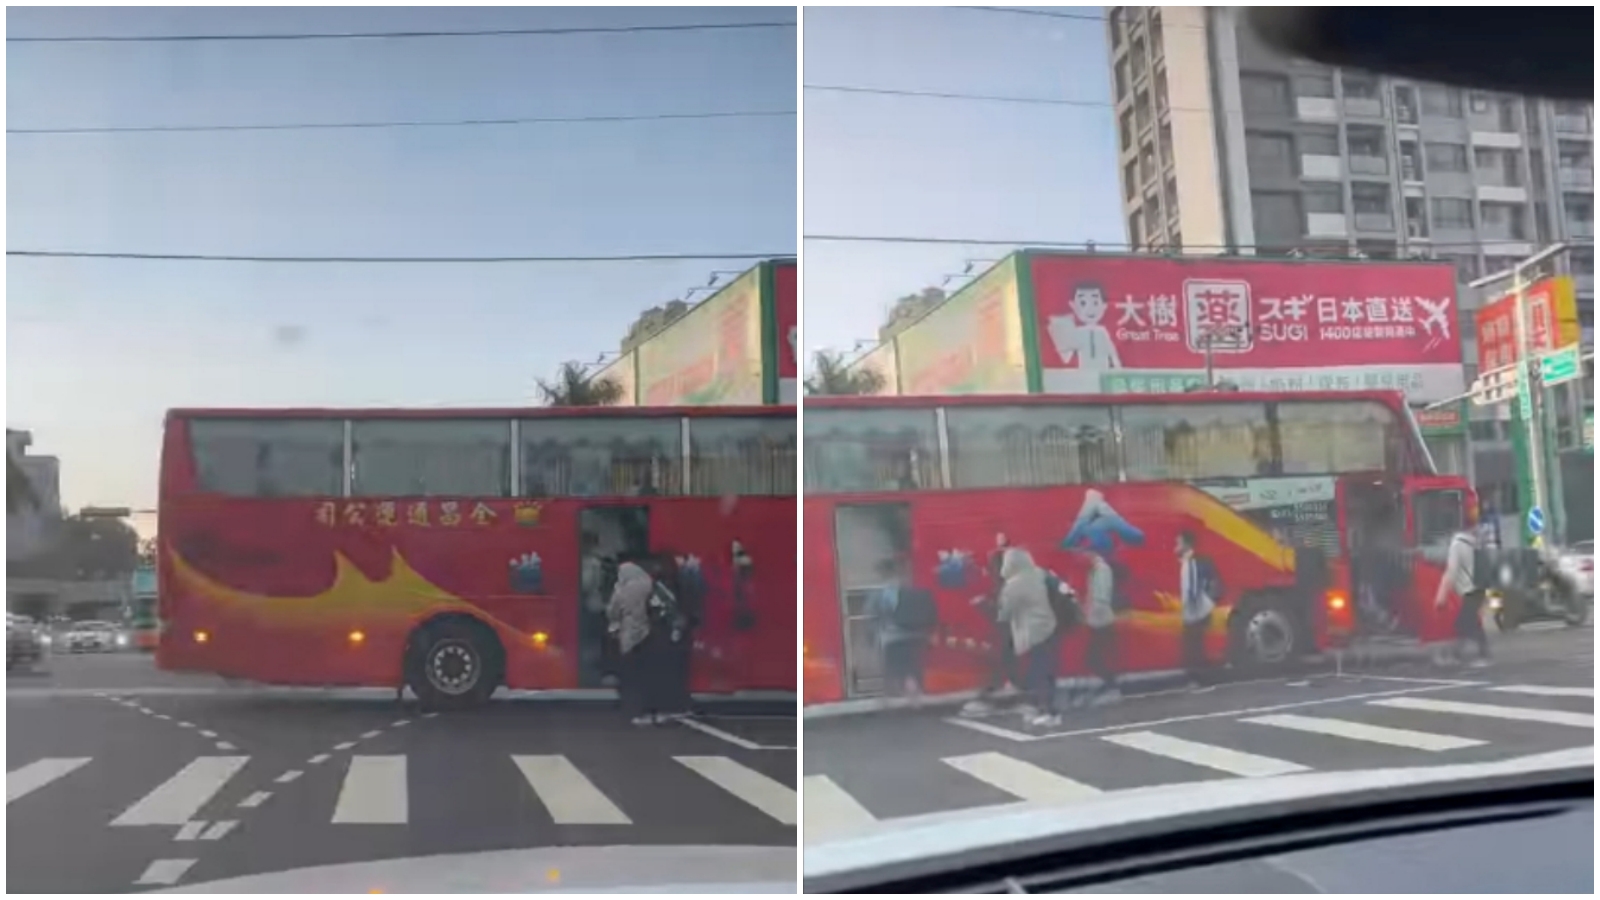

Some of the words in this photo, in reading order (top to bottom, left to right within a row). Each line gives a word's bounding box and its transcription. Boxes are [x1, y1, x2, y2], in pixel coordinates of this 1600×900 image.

[1115, 294, 1178, 326] 大樹
[1259, 295, 1314, 320] スギ
[1317, 296, 1414, 322] 日本直送
[1115, 327, 1150, 341] Great
[1260, 323, 1308, 341] SUGI
